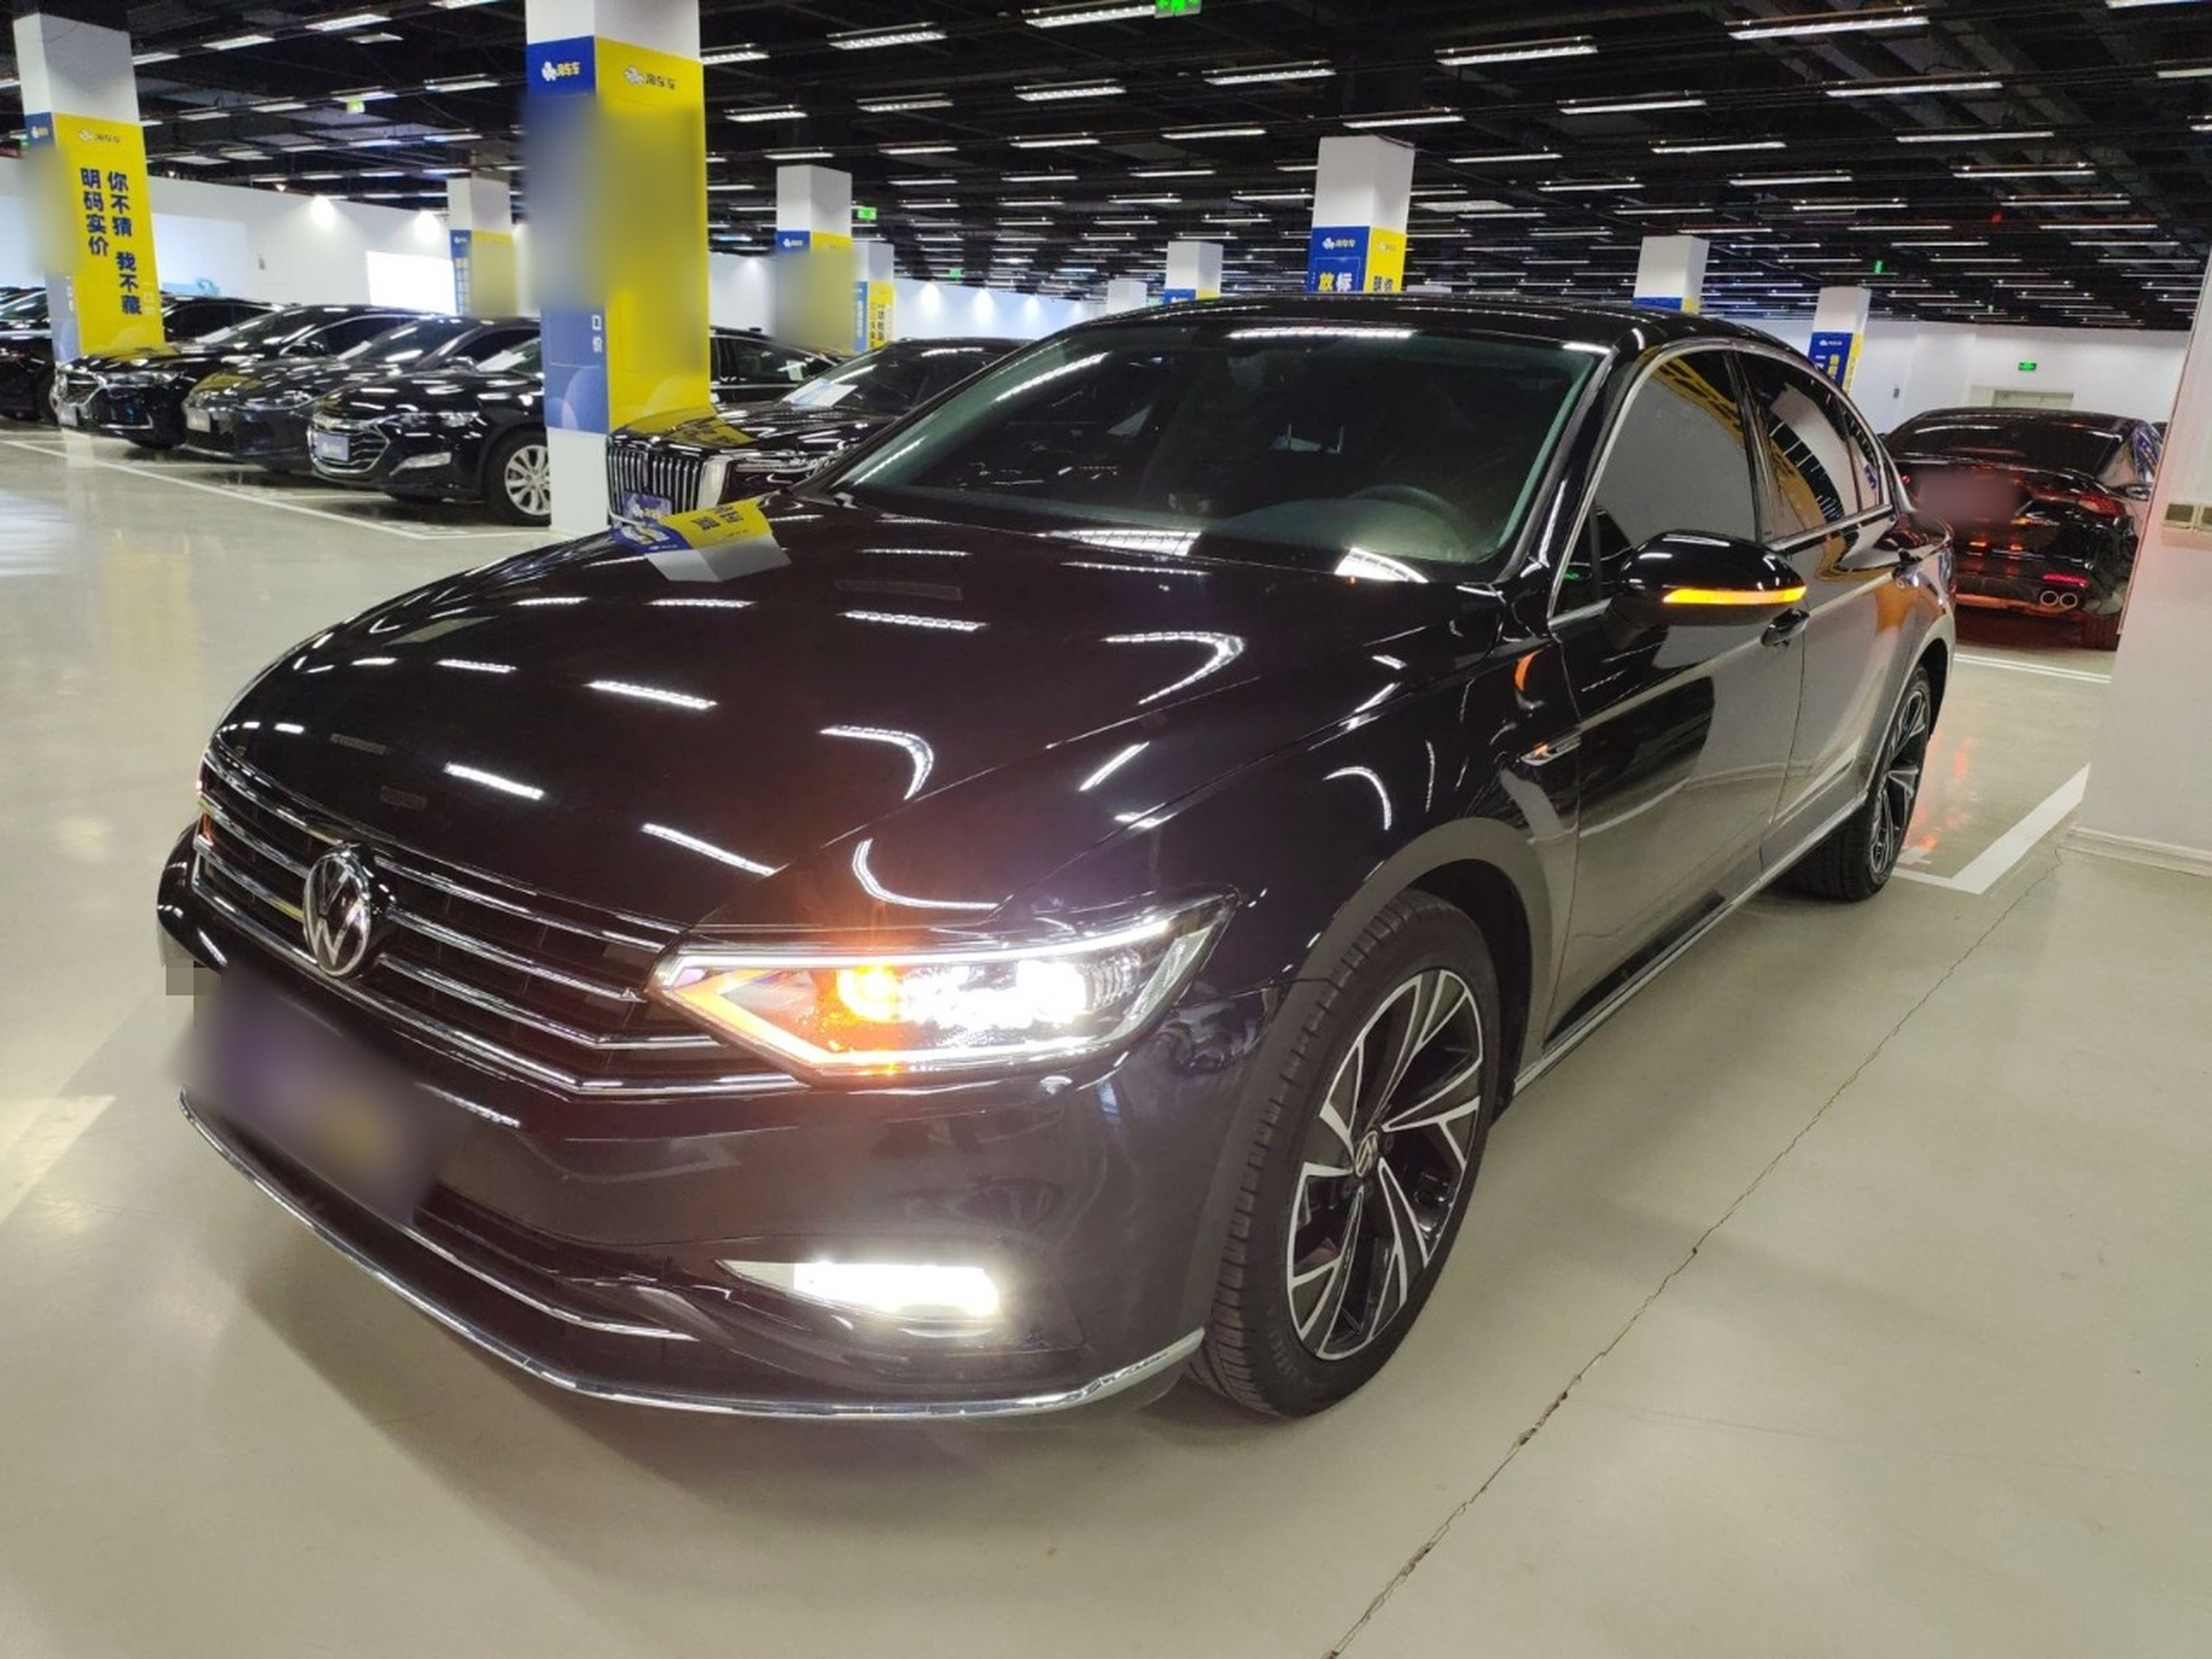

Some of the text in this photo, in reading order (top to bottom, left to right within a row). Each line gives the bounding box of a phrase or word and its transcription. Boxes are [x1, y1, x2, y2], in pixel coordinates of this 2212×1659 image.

[81, 168, 108, 256] 明码实价
[108, 171, 132, 237] 你不猜
[116, 251, 142, 315] 我不藏
